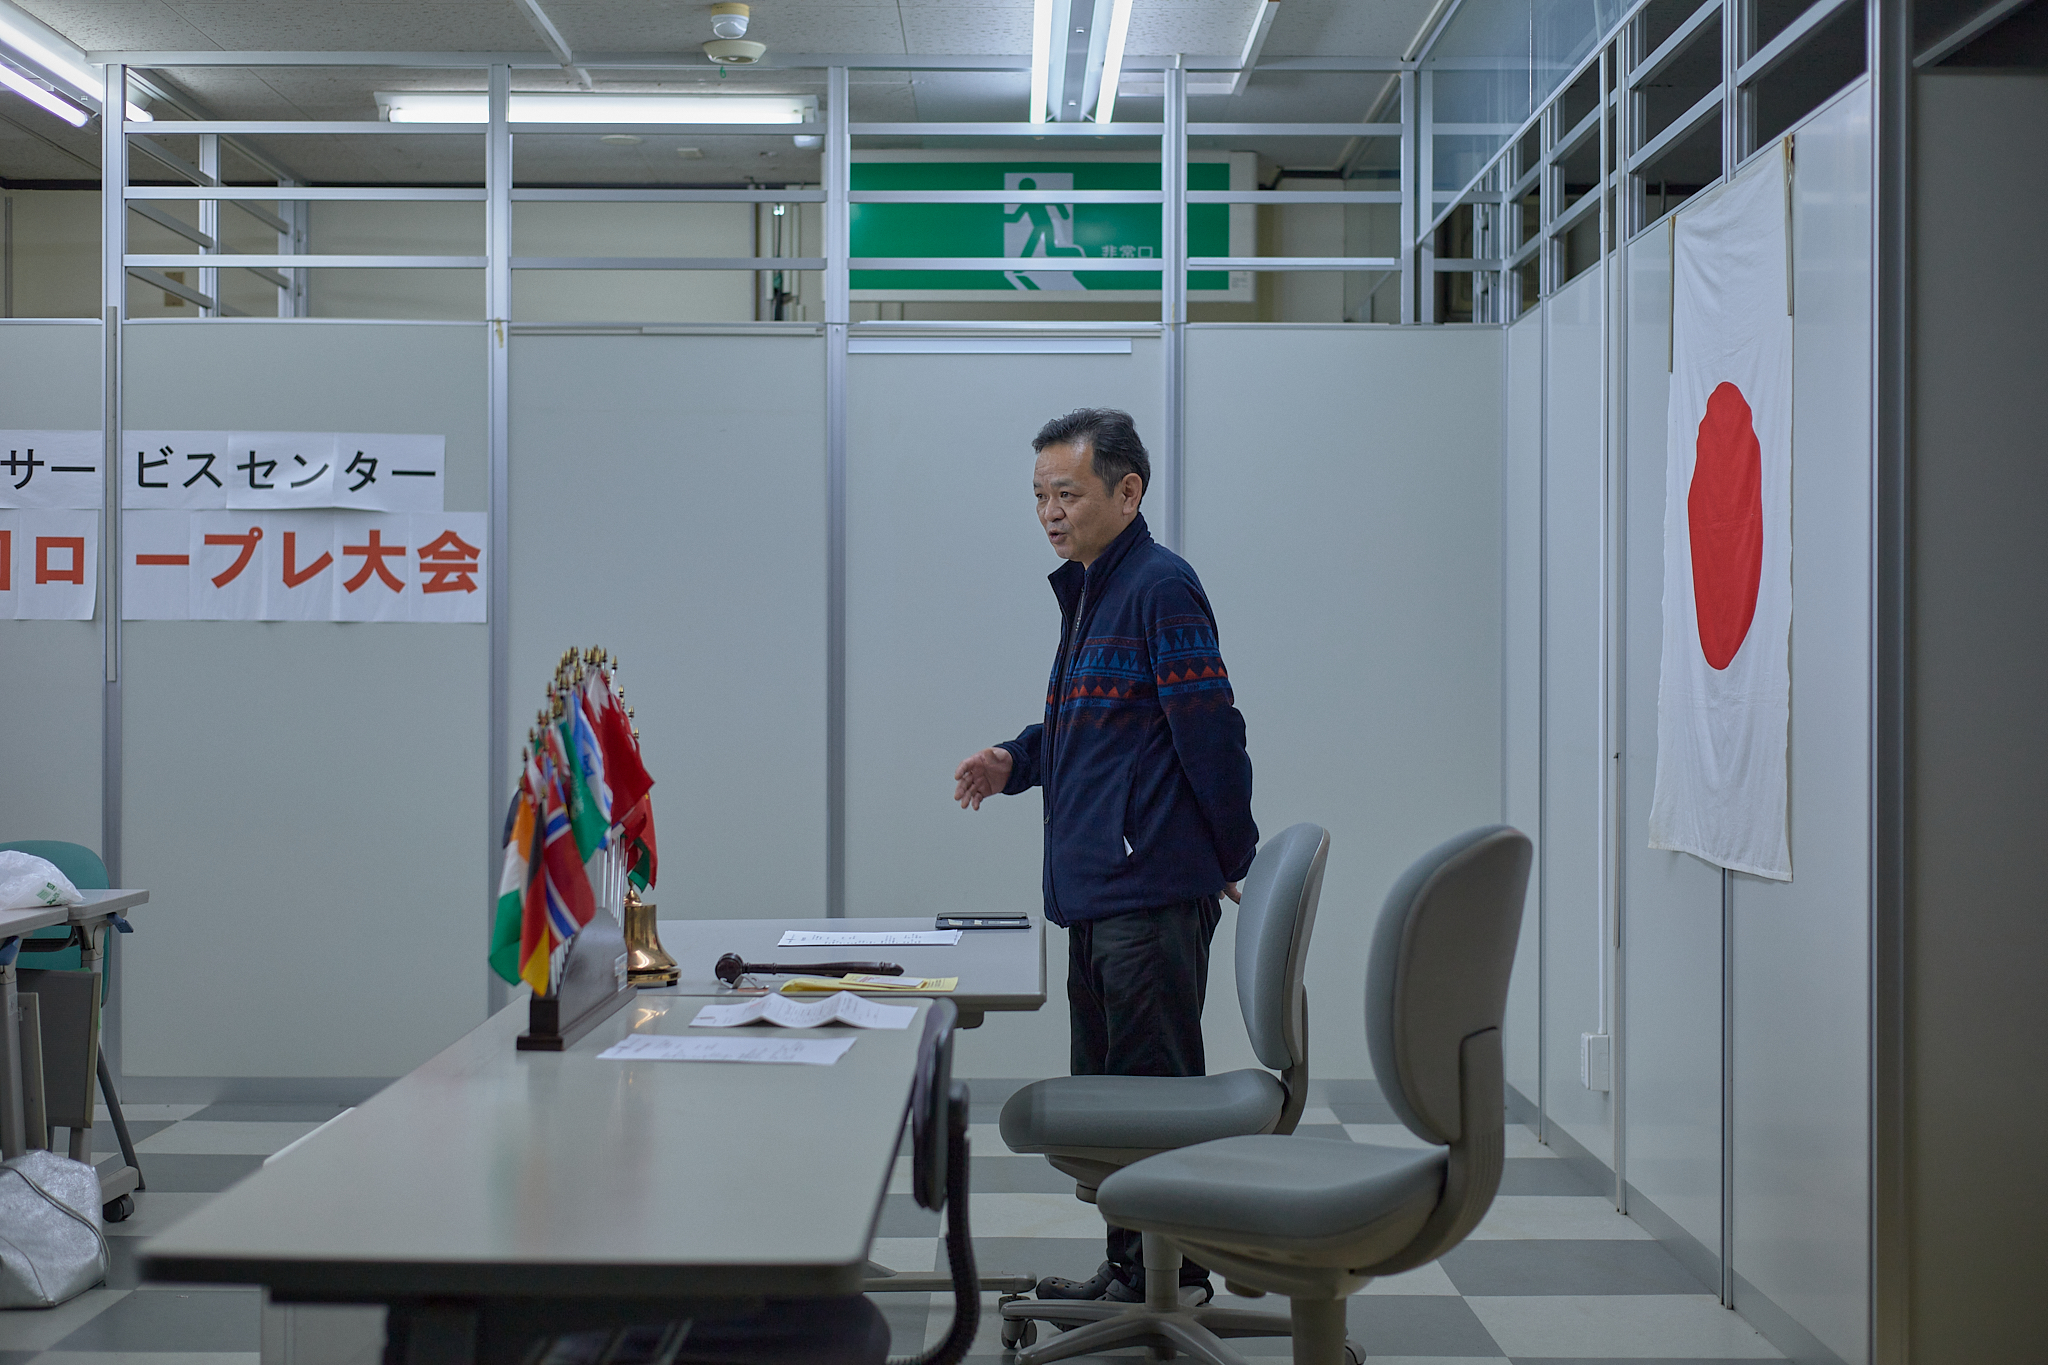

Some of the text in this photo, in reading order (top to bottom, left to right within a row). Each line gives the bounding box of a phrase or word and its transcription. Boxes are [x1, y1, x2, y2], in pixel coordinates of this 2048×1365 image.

[1102, 244, 1153, 258] 非常口
[0, 445, 436, 492] サービスセンター
[0, 526, 481, 594] ロープレ大会
